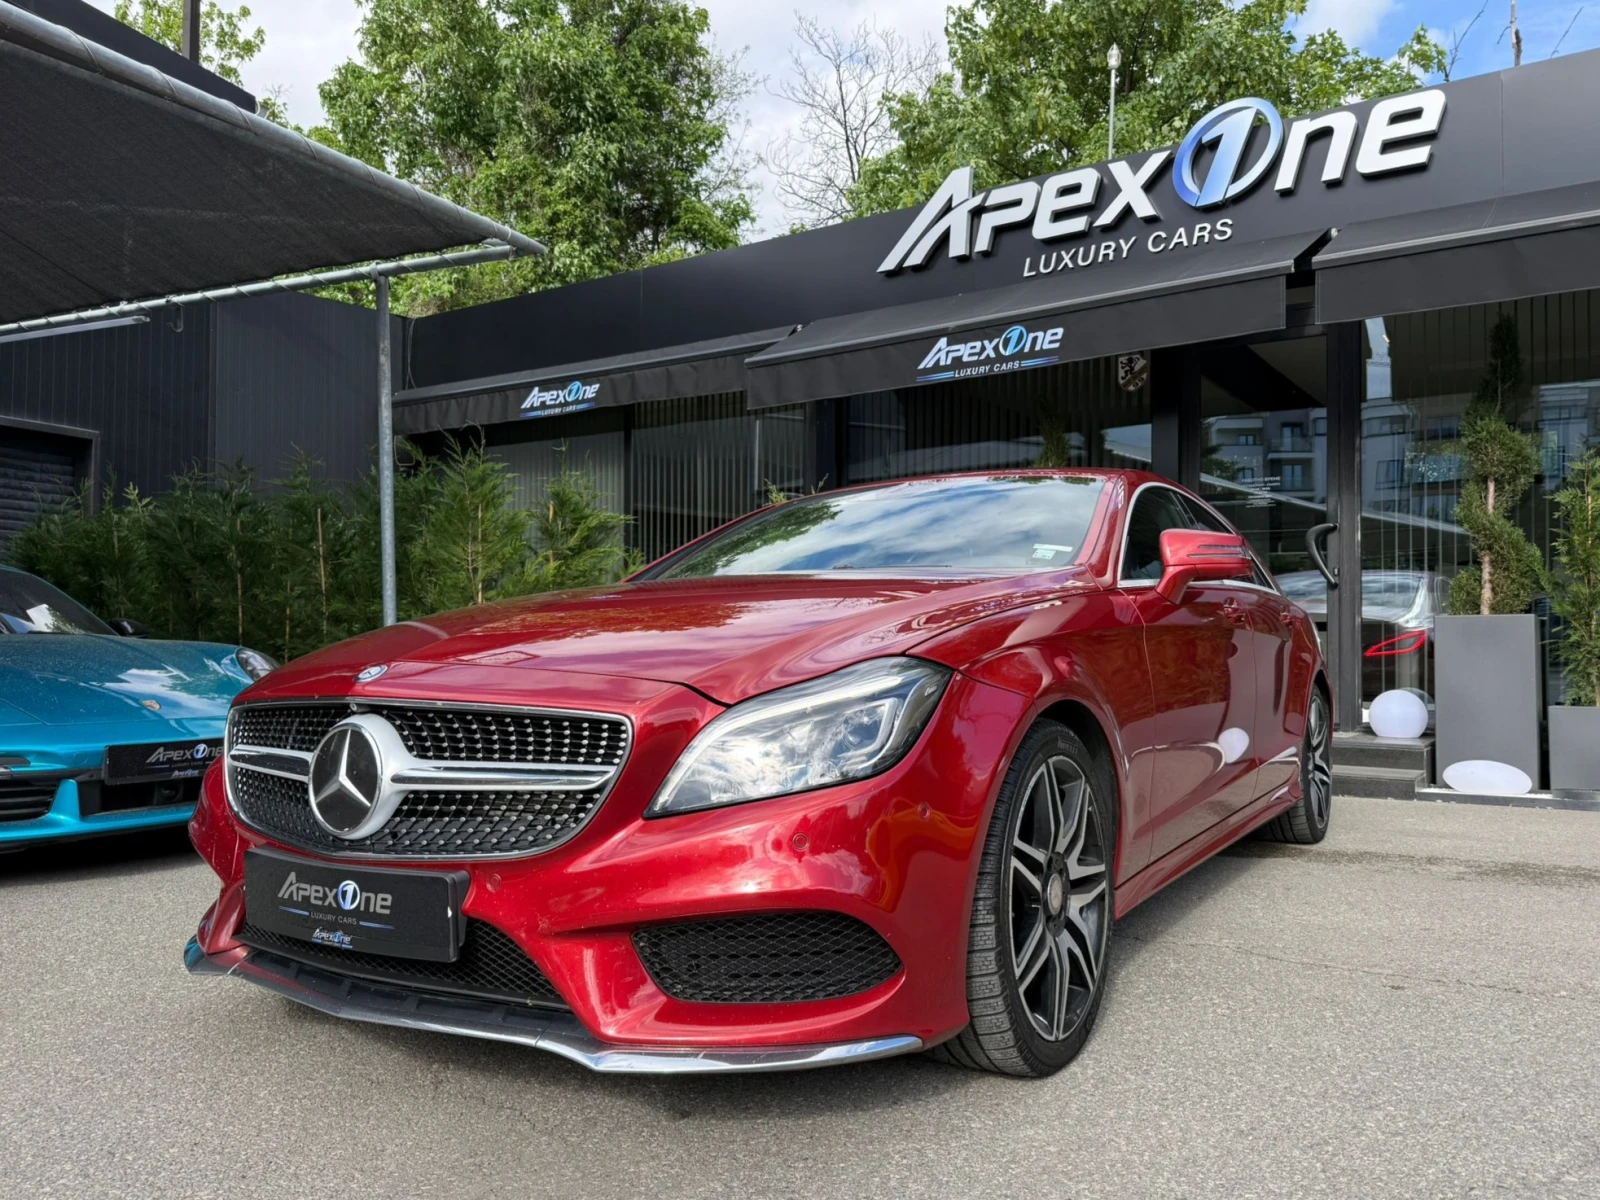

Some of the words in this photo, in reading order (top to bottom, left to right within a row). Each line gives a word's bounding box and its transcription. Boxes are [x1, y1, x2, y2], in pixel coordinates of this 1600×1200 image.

[1023, 235, 1137, 277] LUXURY
[1147, 218, 1234, 252] CARS
[954, 365, 990, 378] LUXURY
[994, 361, 1020, 372] CARS
[541, 408, 562, 416] LUXURY
[562, 405, 576, 413] CARS
[310, 911, 336, 922] LUXURY
[337, 914, 357, 925] CARS
